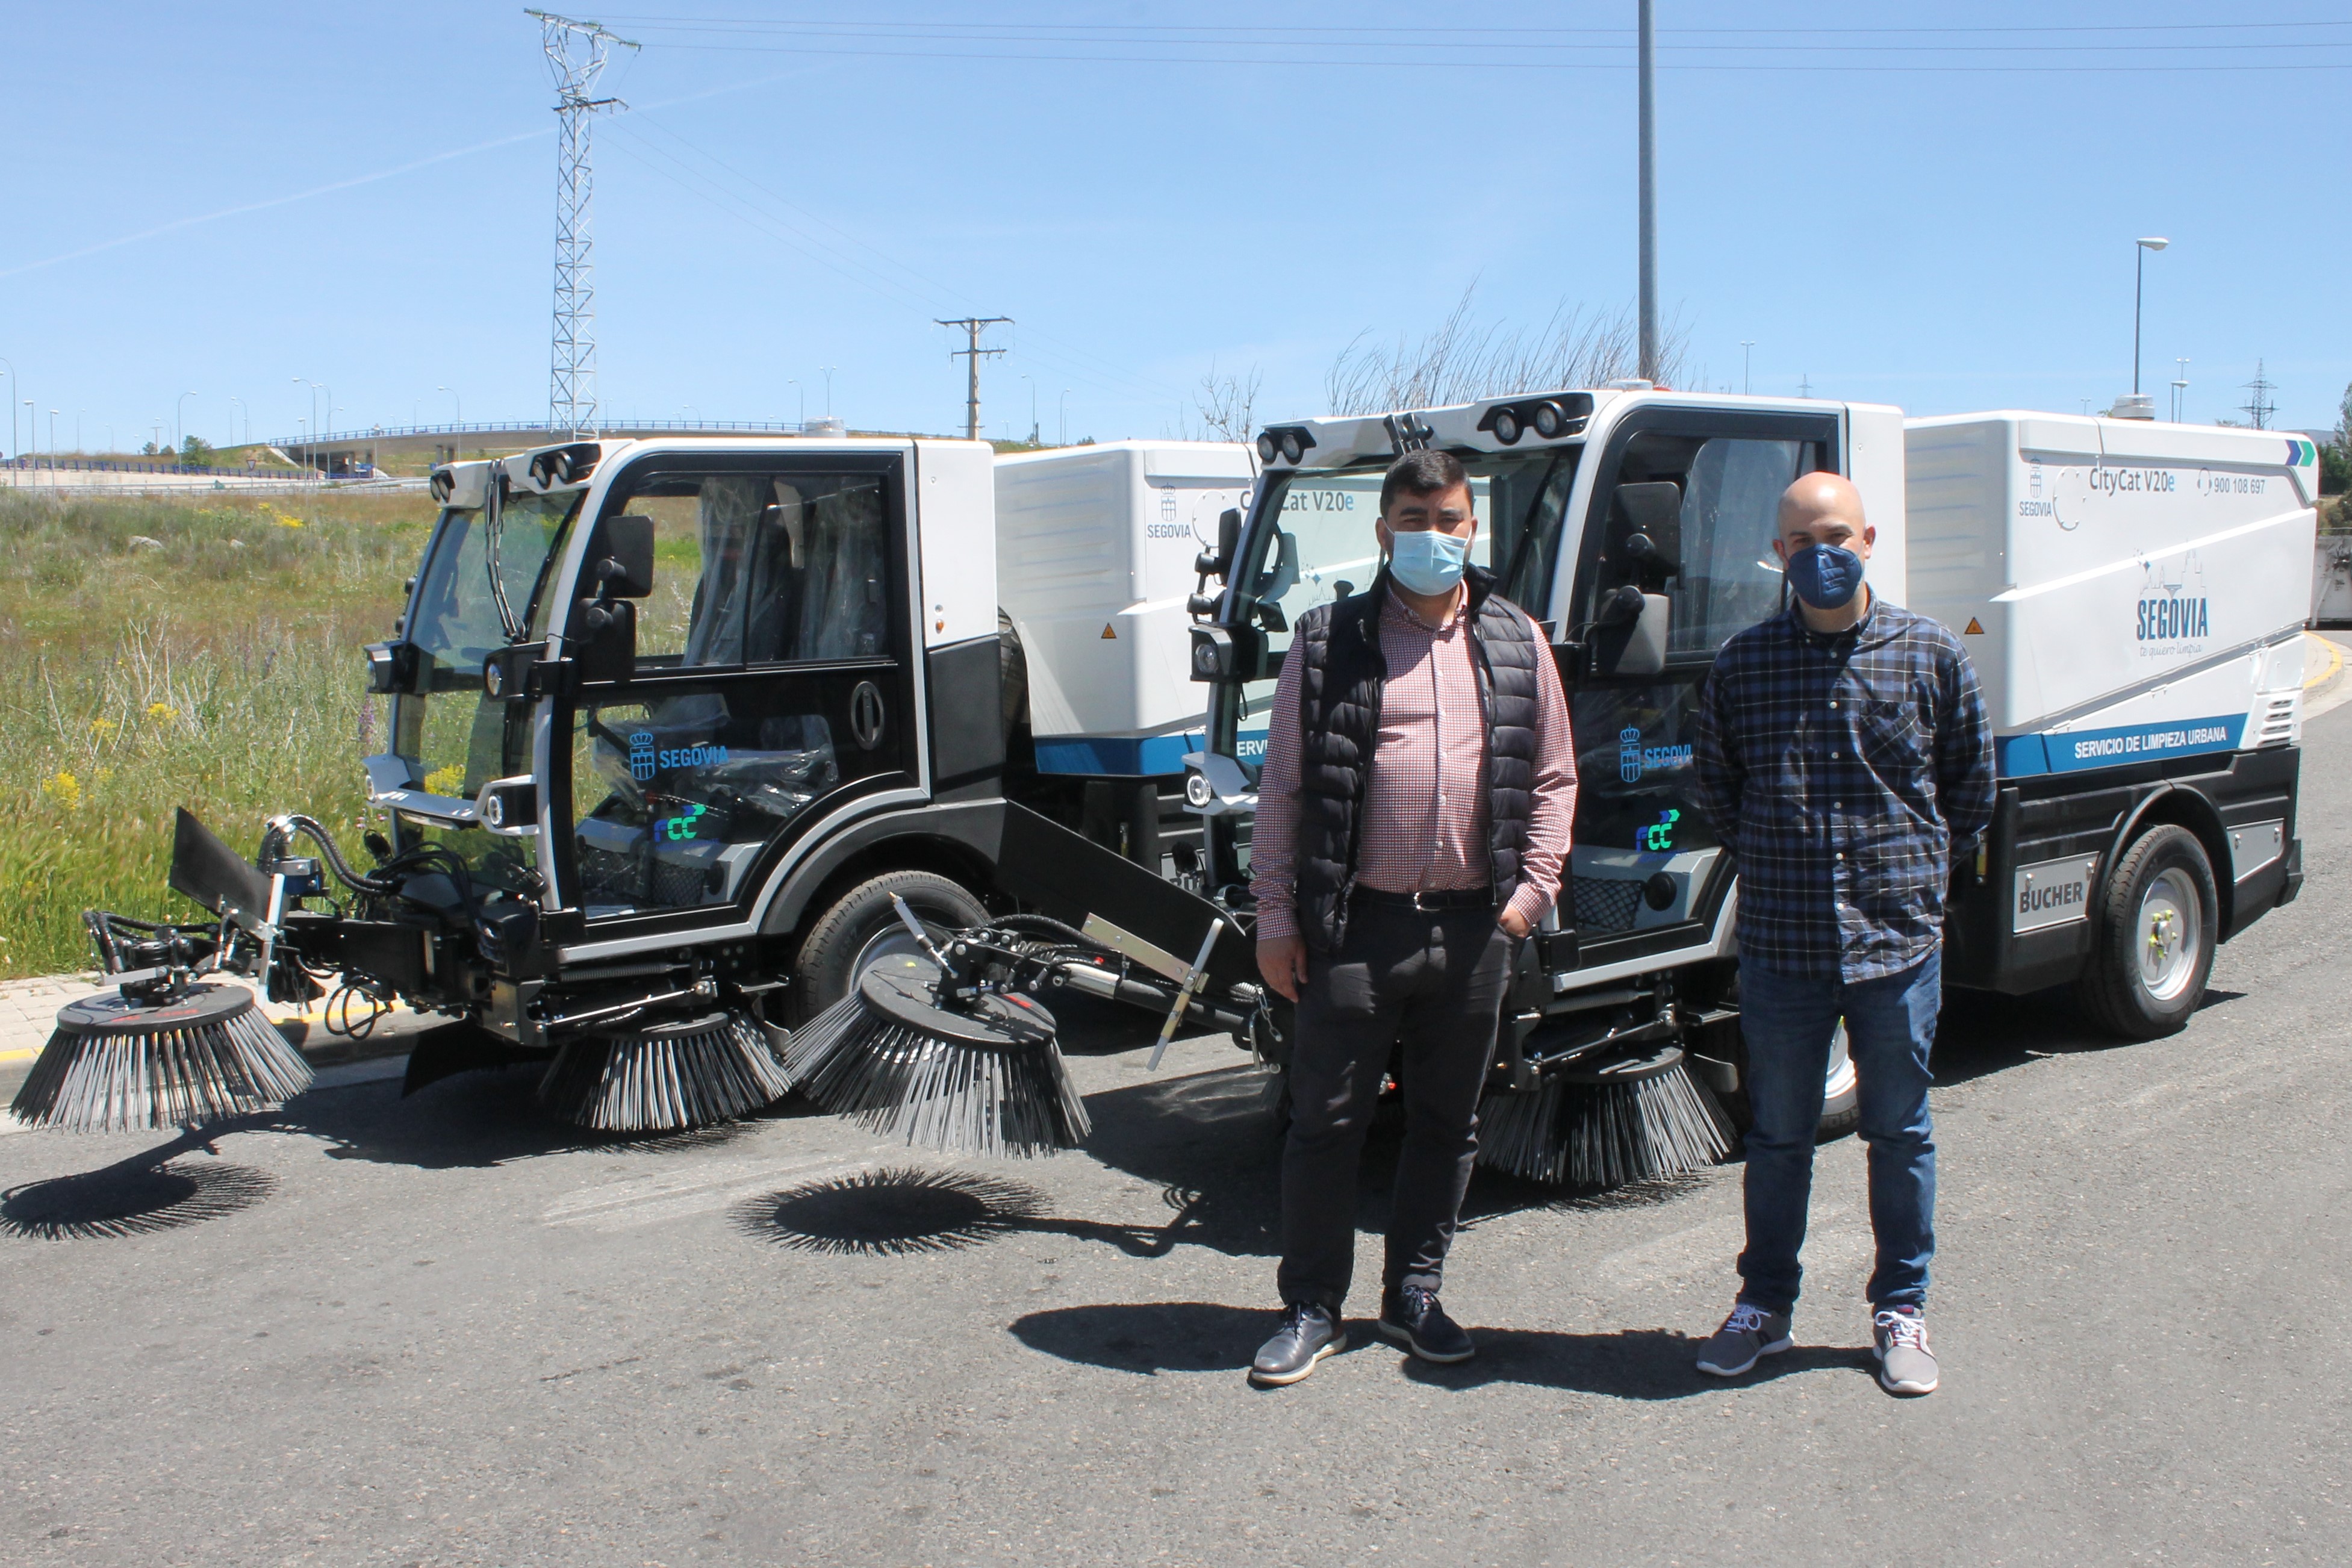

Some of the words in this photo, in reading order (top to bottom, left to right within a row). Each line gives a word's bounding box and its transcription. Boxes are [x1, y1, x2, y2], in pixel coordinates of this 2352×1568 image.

[2089, 468, 2141, 497] CityCat
[2144, 470, 2175, 492] V20e
[2214, 478, 2230, 493] 900
[2233, 478, 2248, 494] 108
[2250, 479, 2265, 494] 697
[1312, 491, 1354, 512] V20e
[2019, 501, 2052, 517] SEGOVIA
[1147, 524, 1191, 539] SEGOVIA
[2136, 597, 2208, 641] SEGOVIA
[2139, 646, 2147, 658] te
[2148, 645, 2176, 661] quiero
[2176, 641, 2202, 658] limpia
[2074, 738, 2124, 759] SERVICIO
[2126, 736, 2140, 753] DE
[2142, 730, 2186, 751] LIMPIEZA
[2188, 726, 2227, 745] URBANA
[659, 745, 729, 769] SEGOVIA
[1644, 744, 1693, 769] SEGOVI
[2019, 882, 2083, 913] BUCHER
